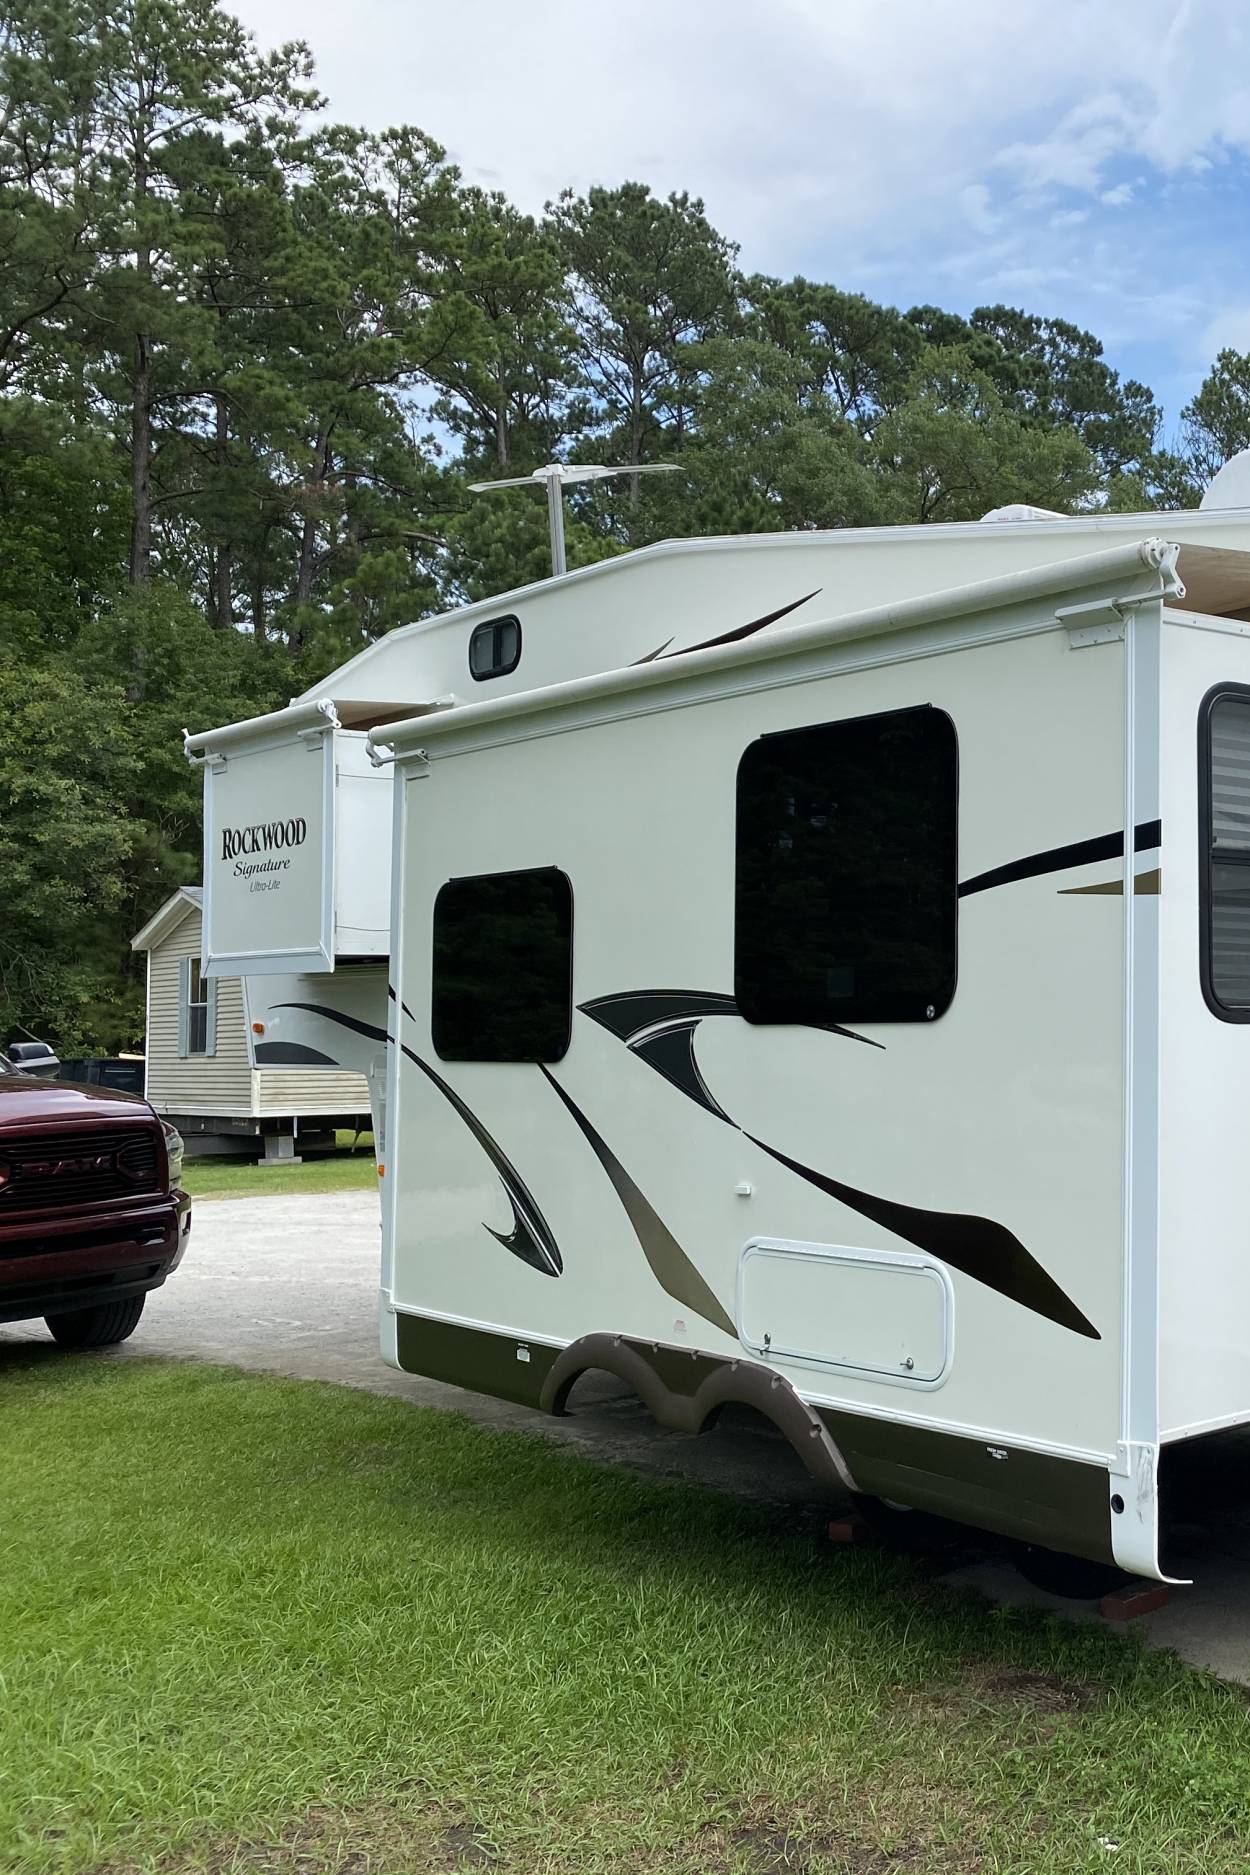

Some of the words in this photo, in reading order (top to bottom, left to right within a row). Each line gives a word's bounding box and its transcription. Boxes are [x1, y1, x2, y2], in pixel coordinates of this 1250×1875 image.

[221, 817, 307, 860] ROCKWOOD
[233, 859, 291, 879] Signature
[249, 880, 281, 893] Ultra-Lite
